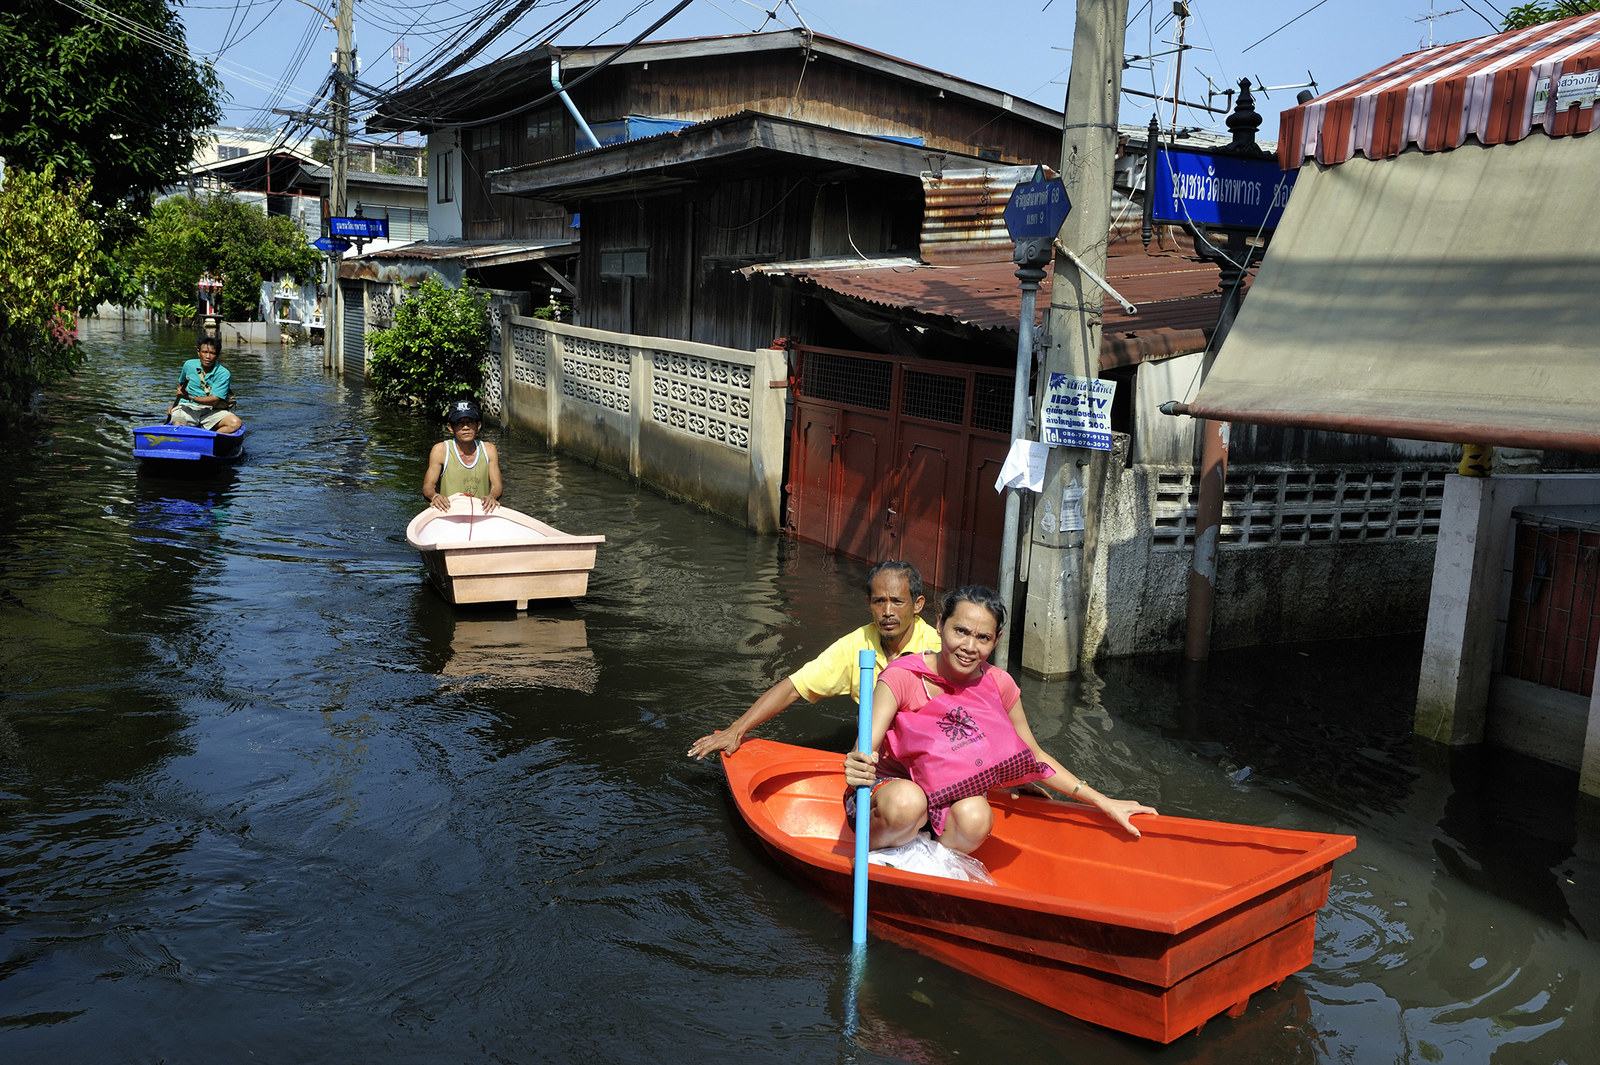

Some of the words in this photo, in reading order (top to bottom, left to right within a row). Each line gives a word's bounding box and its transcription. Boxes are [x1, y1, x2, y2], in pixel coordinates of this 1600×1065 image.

[1051, 187, 1060, 204] 68
[1172, 165, 1261, 212] ชุมชนวัดเทพากร
[1273, 183, 1293, 208] ซอ
[1039, 211, 1045, 224] 9
